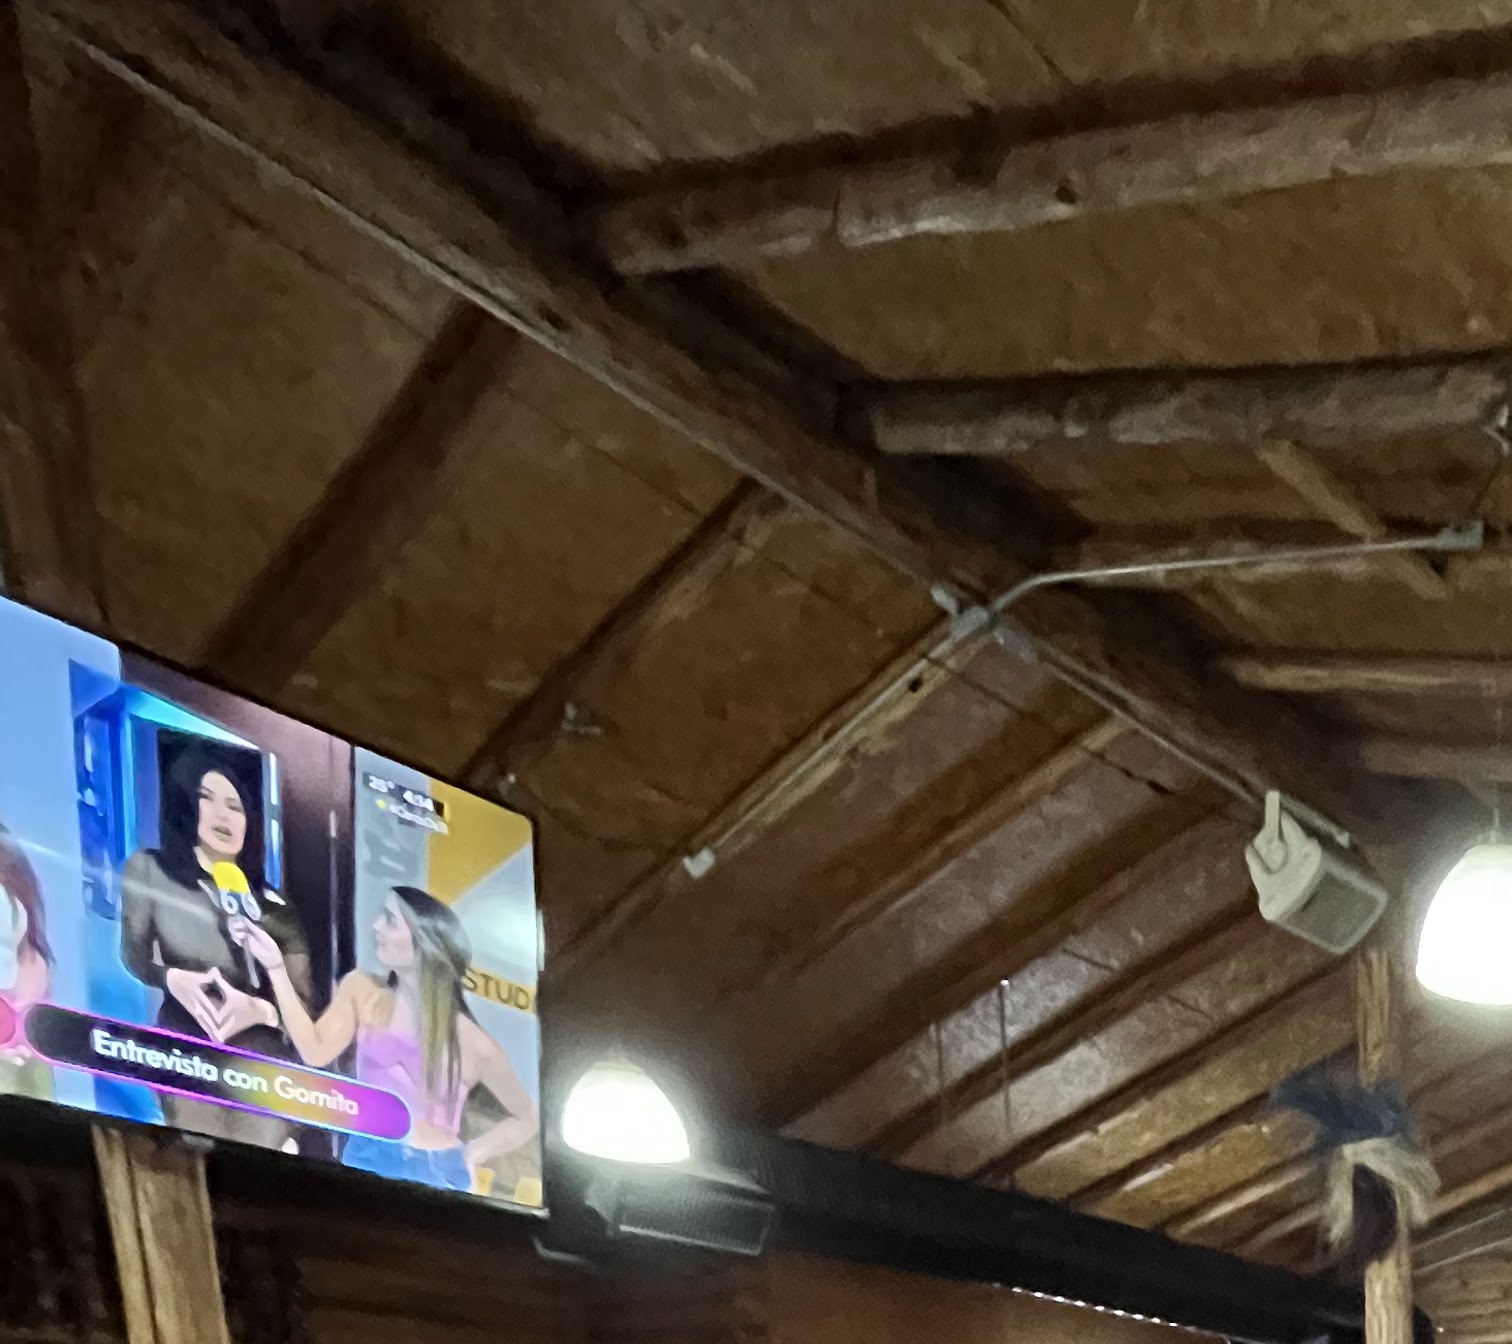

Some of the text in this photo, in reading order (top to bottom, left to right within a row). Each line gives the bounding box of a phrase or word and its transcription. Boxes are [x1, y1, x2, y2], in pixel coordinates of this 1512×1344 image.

[91, 1028, 360, 1116] Entrevista con Gomita
